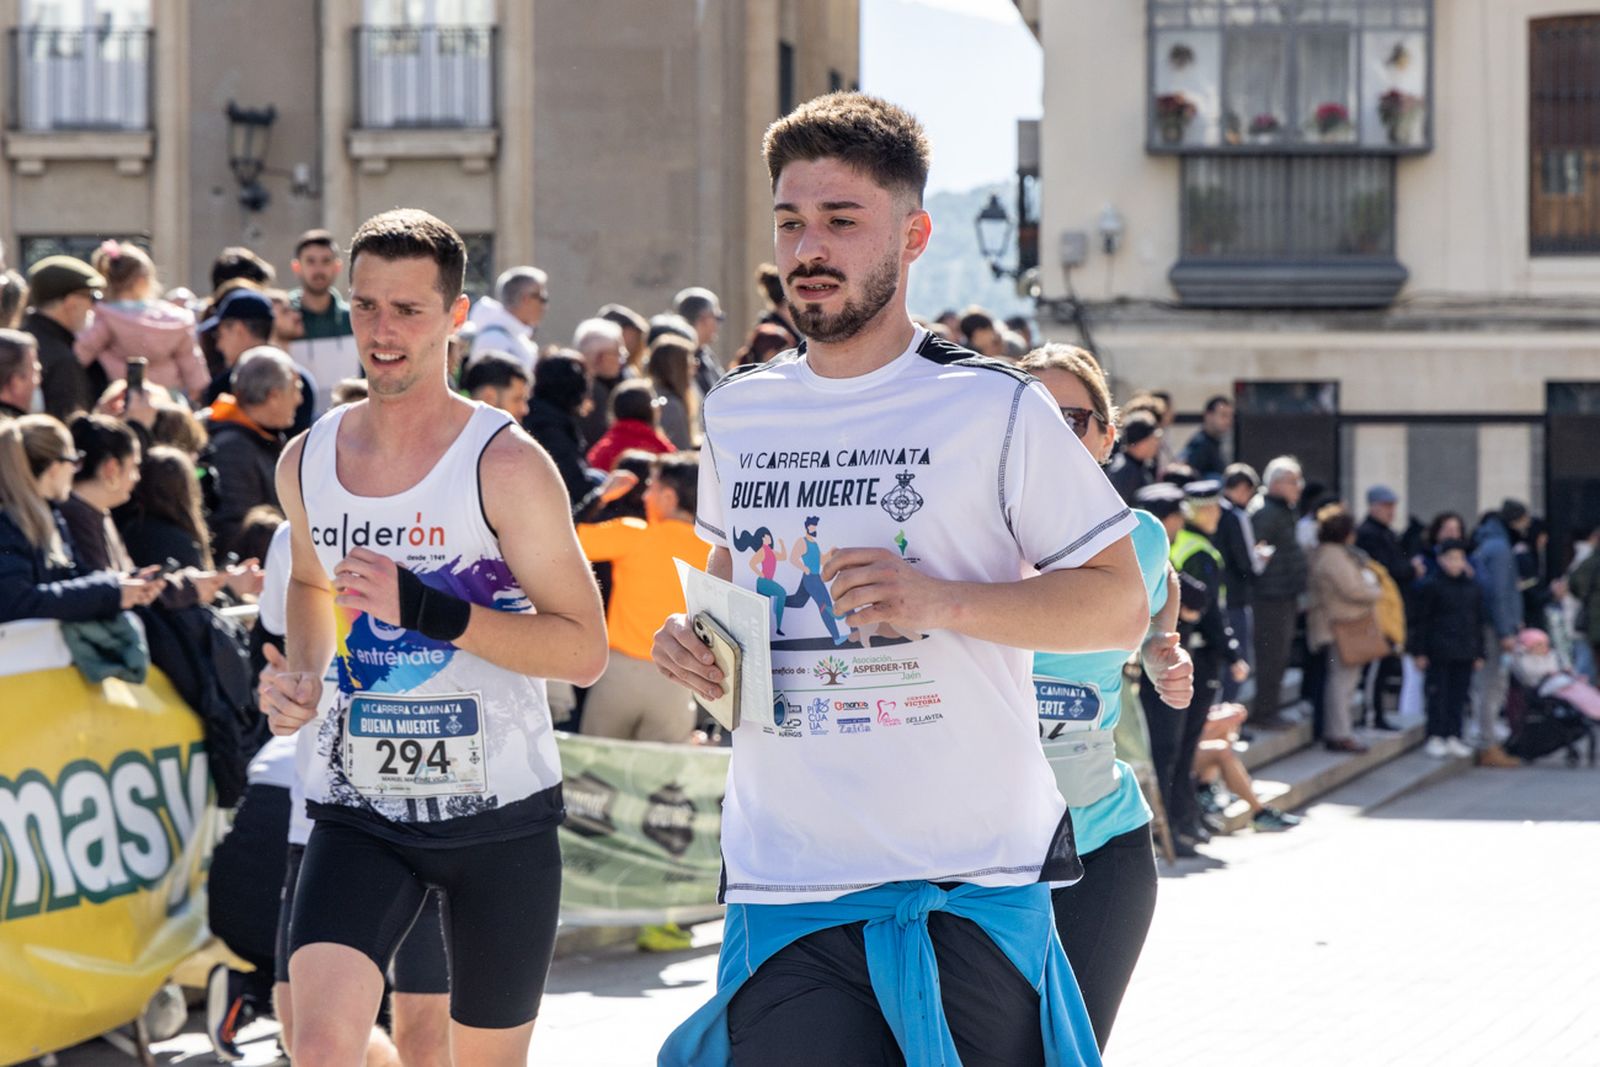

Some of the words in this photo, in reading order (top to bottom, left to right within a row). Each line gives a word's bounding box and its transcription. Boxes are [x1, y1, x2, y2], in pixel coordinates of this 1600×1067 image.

[739, 454, 753, 469] VI
[756, 450, 831, 469] CARRERA
[836, 447, 931, 468] CAMINATA
[731, 480, 790, 509] BUENA
[797, 477, 880, 508] MUERTE
[311, 512, 446, 559] calderón
[356, 646, 445, 666] entrénate
[852, 655, 892, 665] Asociación
[796, 666, 806, 675] de
[853, 662, 920, 674] ASPERGER-TEA
[901, 671, 921, 681] Jaén
[1040, 686, 1087, 698] CAMINATA
[361, 705, 370, 714] VI
[371, 704, 411, 715] CARRERA
[412, 703, 462, 715] CAMINATA
[904, 697, 942, 707] VICTORIA
[1038, 700, 1066, 716] ERTE
[360, 717, 394, 734] BUENA
[396, 719, 441, 735] MUERTE
[375, 739, 451, 775] 294
